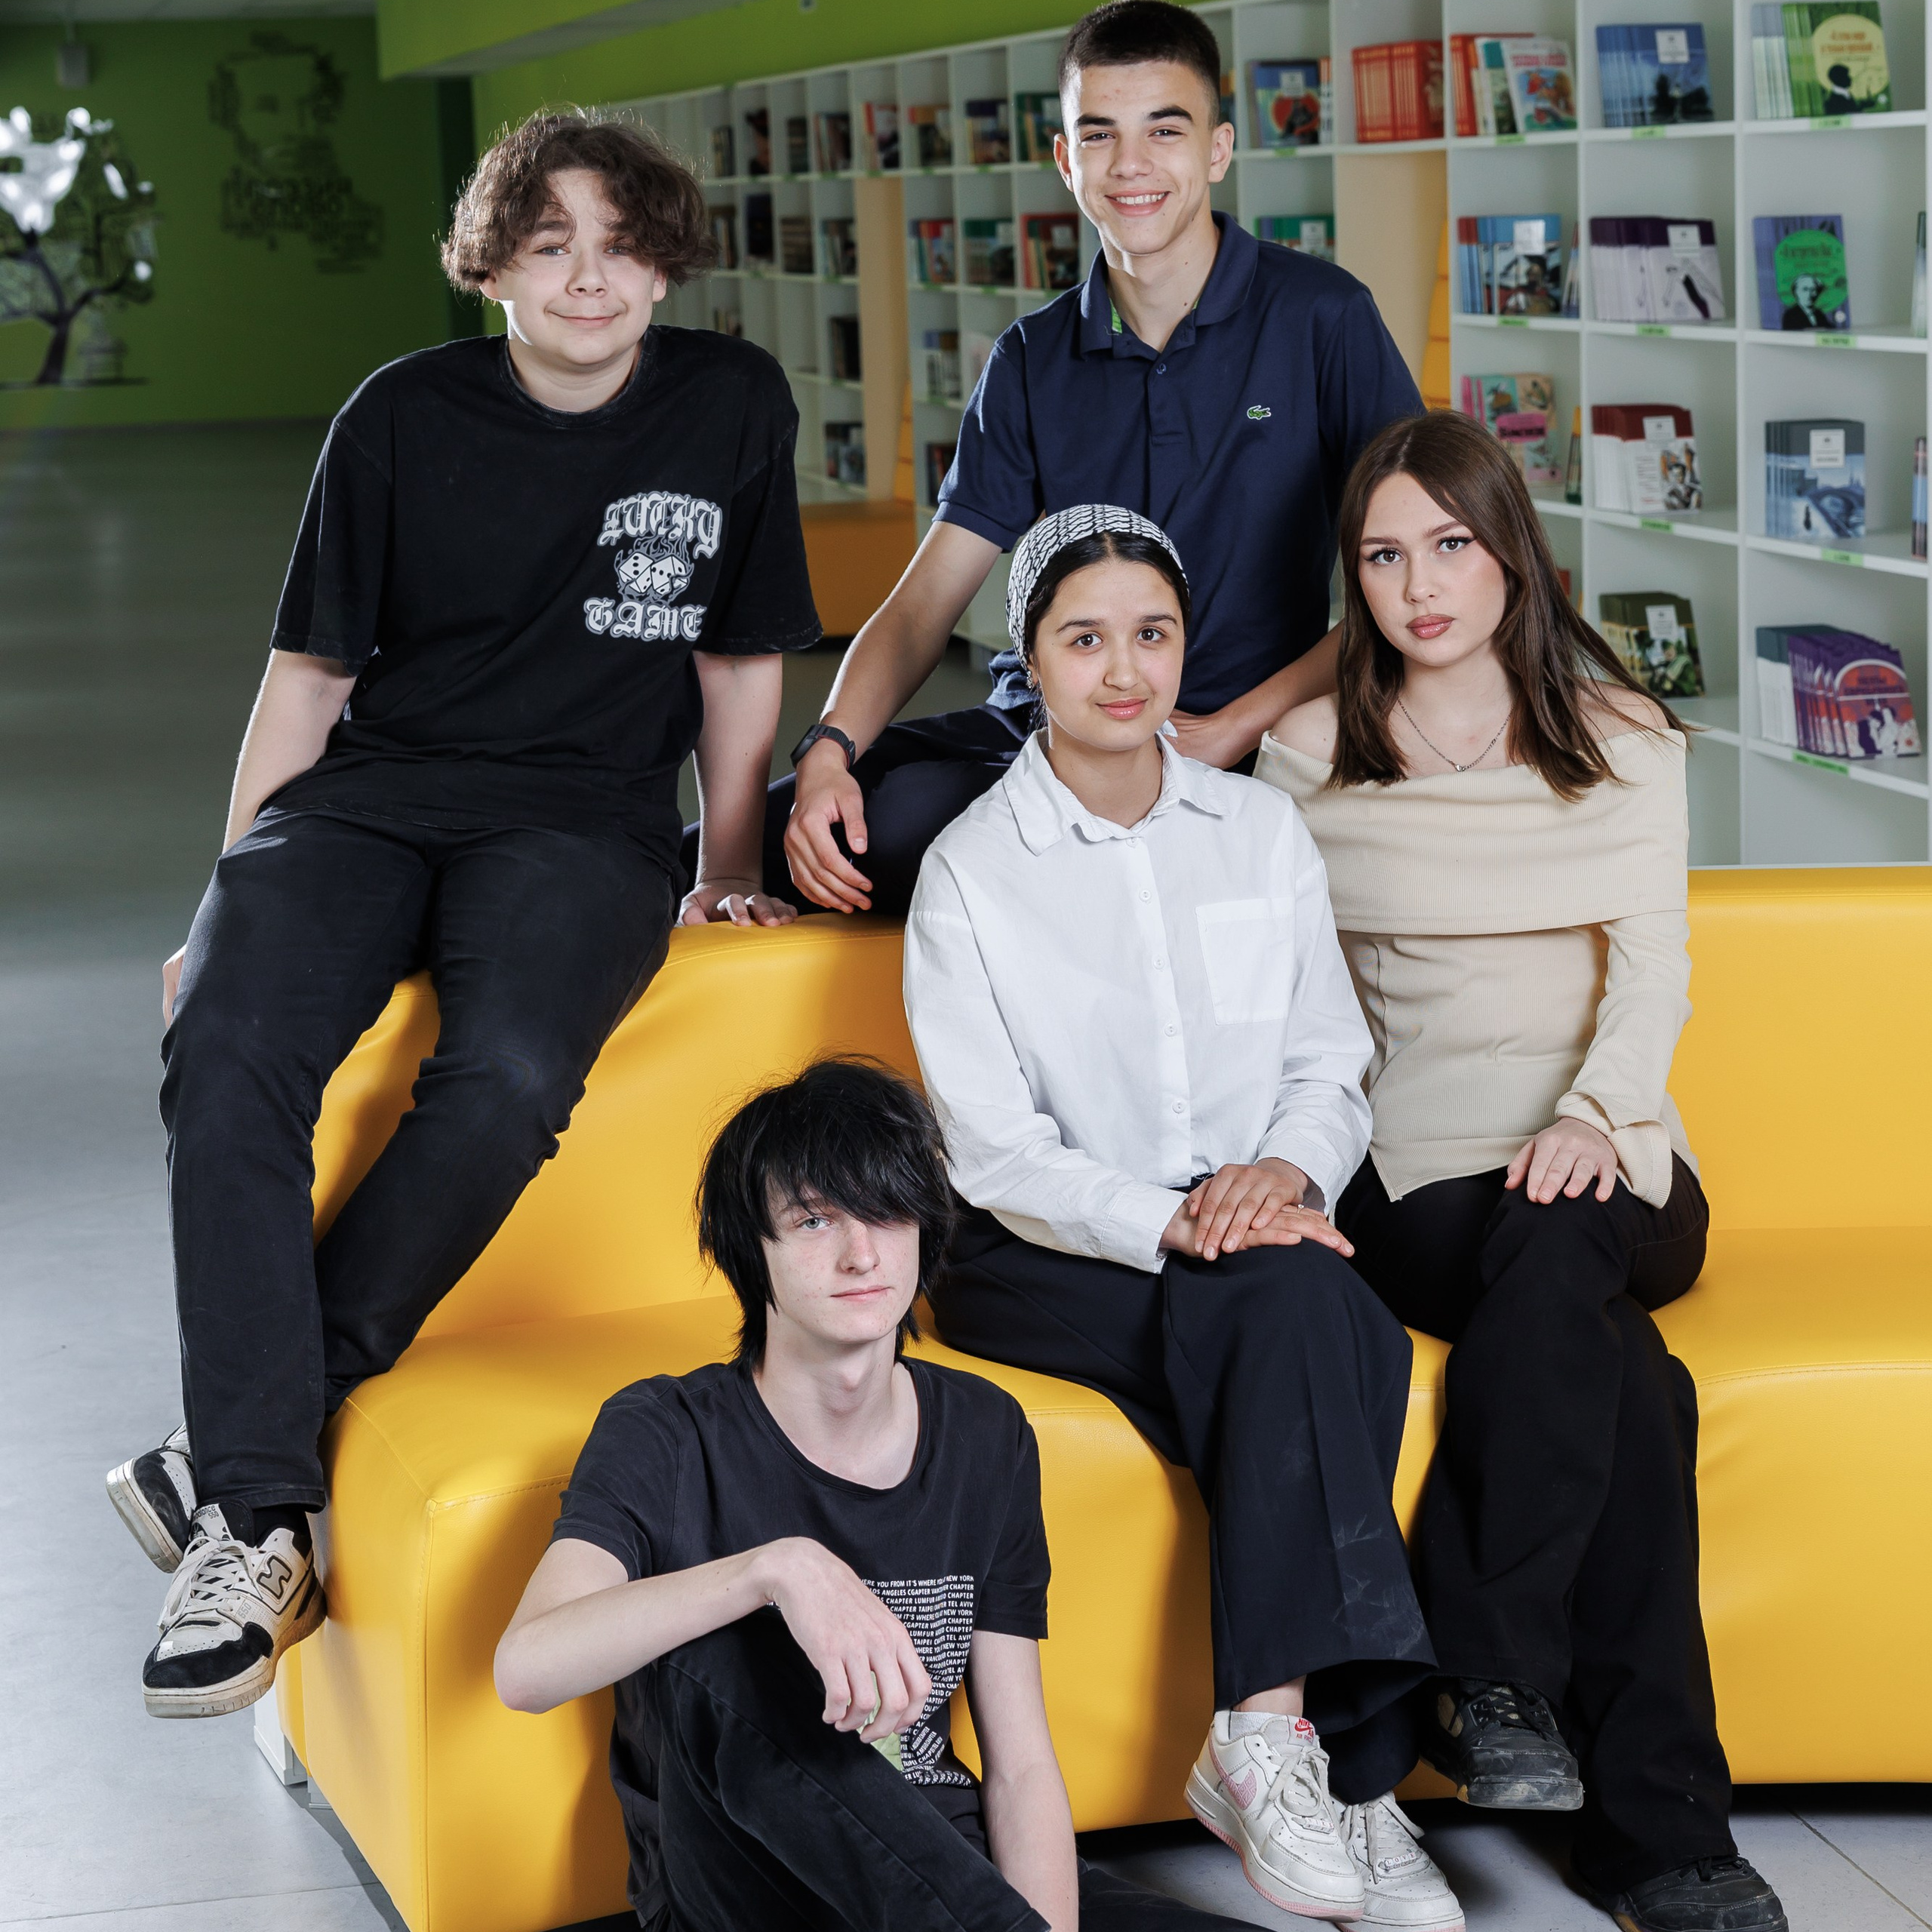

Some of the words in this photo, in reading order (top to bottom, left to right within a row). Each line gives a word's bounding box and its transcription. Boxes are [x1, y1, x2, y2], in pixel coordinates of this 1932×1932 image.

[598, 491, 722, 558] LUCKY
[584, 598, 706, 641] GAME
[238, 1604, 251, 1619] 550
